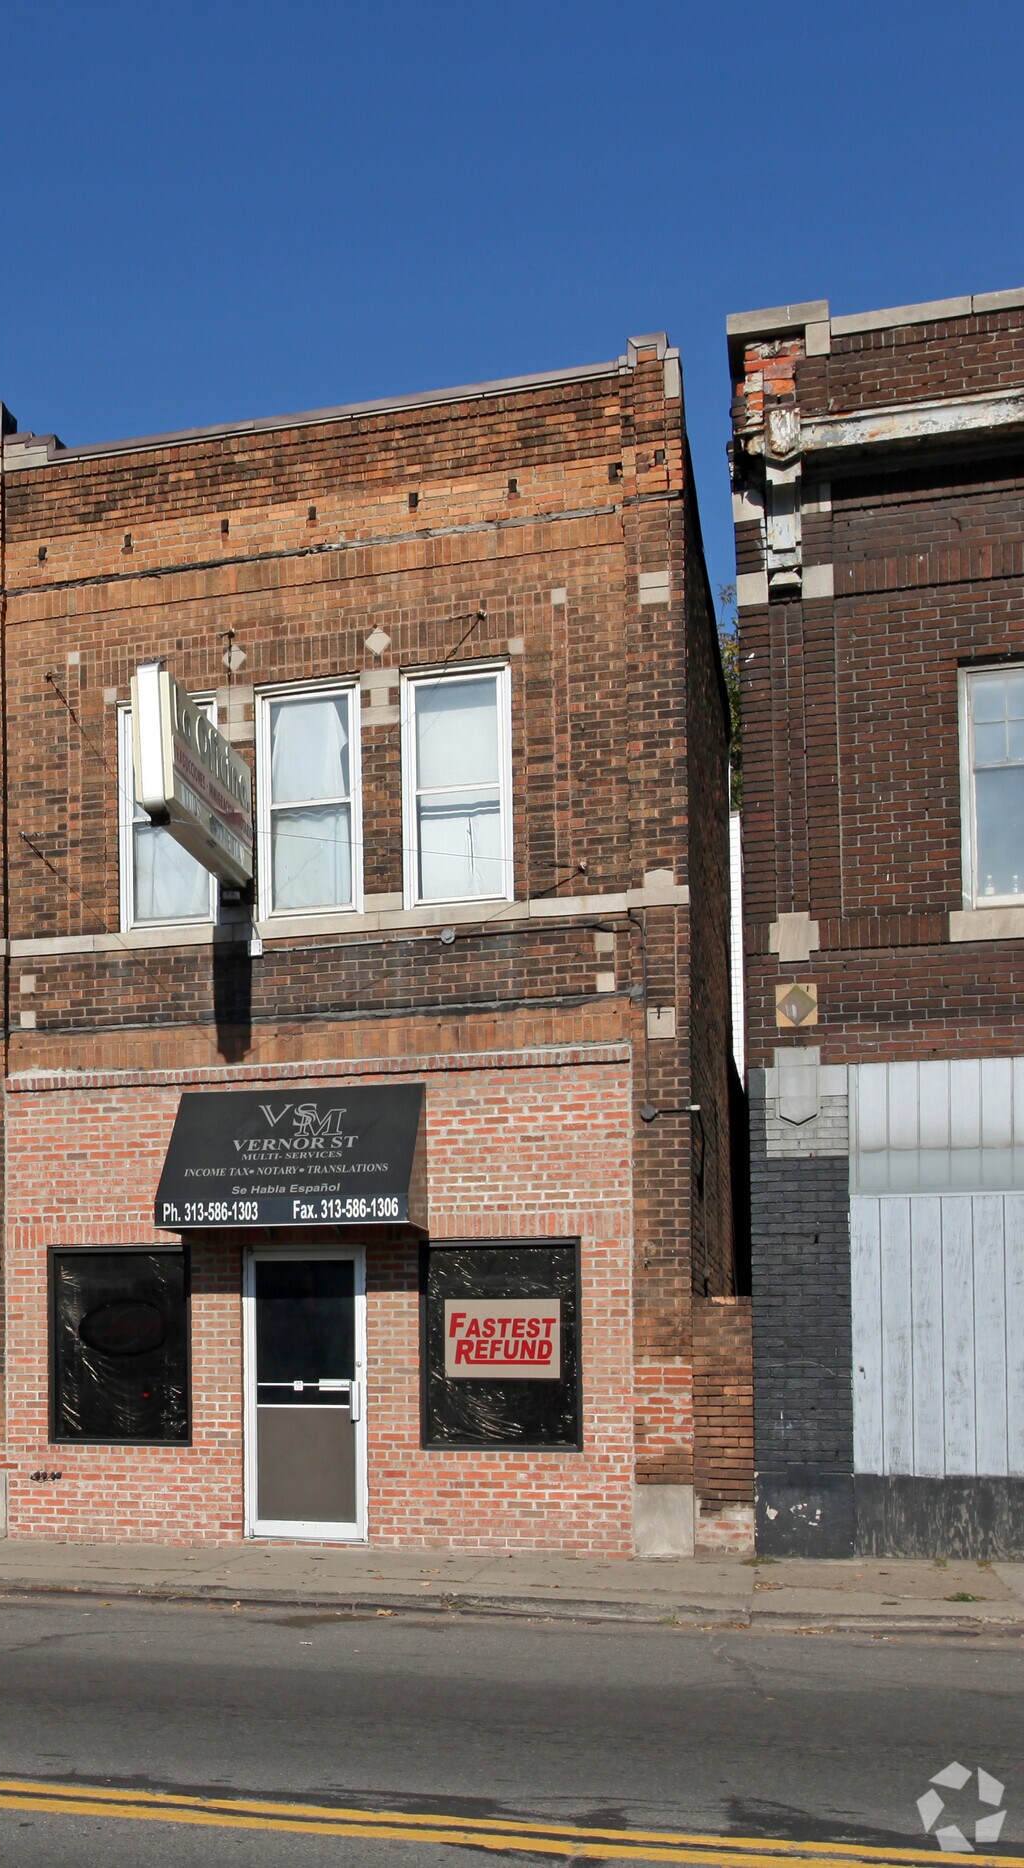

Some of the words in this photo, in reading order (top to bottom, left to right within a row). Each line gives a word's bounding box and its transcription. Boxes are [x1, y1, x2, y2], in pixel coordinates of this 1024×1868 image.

[173, 683, 193, 749] La
[196, 715, 250, 814] Oficina
[233, 1137, 325, 1152] VERNOR
[330, 1135, 359, 1149] ST
[285, 1150, 343, 1160] SERVICES
[184, 1167, 227, 1177] INCOME
[307, 1163, 389, 1174] TRANSLATIONS
[231, 1185, 248, 1195] Se
[251, 1183, 286, 1195] Habla
[290, 1182, 341, 1194] Español
[162, 1202, 182, 1222] Ph.
[184, 1201, 259, 1222] 313-586-1303
[293, 1200, 318, 1220] Fax.
[321, 1197, 399, 1219] 313-586-1306
[449, 1312, 557, 1338] FASTEST
[455, 1339, 554, 1365] REFUND
